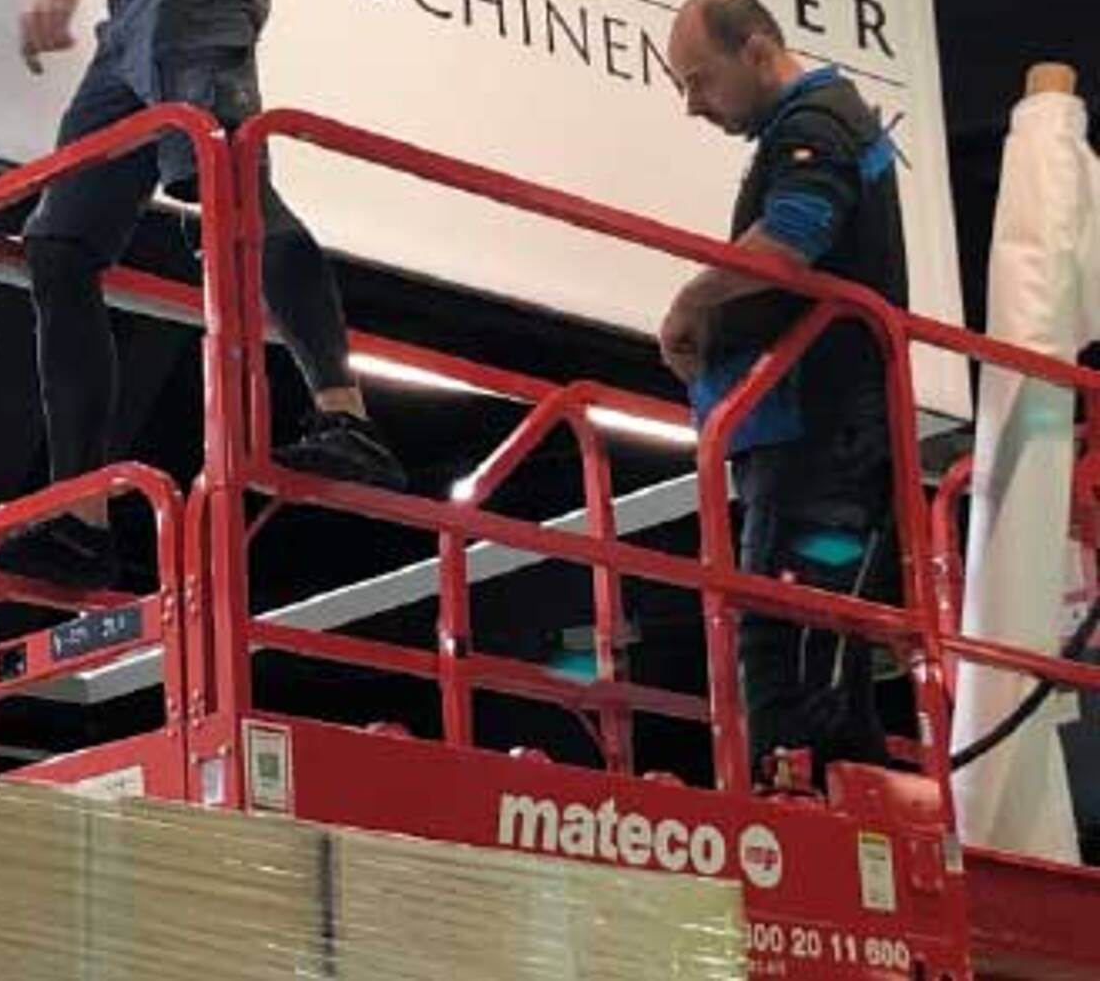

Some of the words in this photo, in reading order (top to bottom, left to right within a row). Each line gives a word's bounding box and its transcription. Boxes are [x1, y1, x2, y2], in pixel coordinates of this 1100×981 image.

[498, 791, 726, 875] mateco
[747, 922, 785, 953] 00
[790, 927, 822, 957] 20
[831, 932, 857, 963] 11
